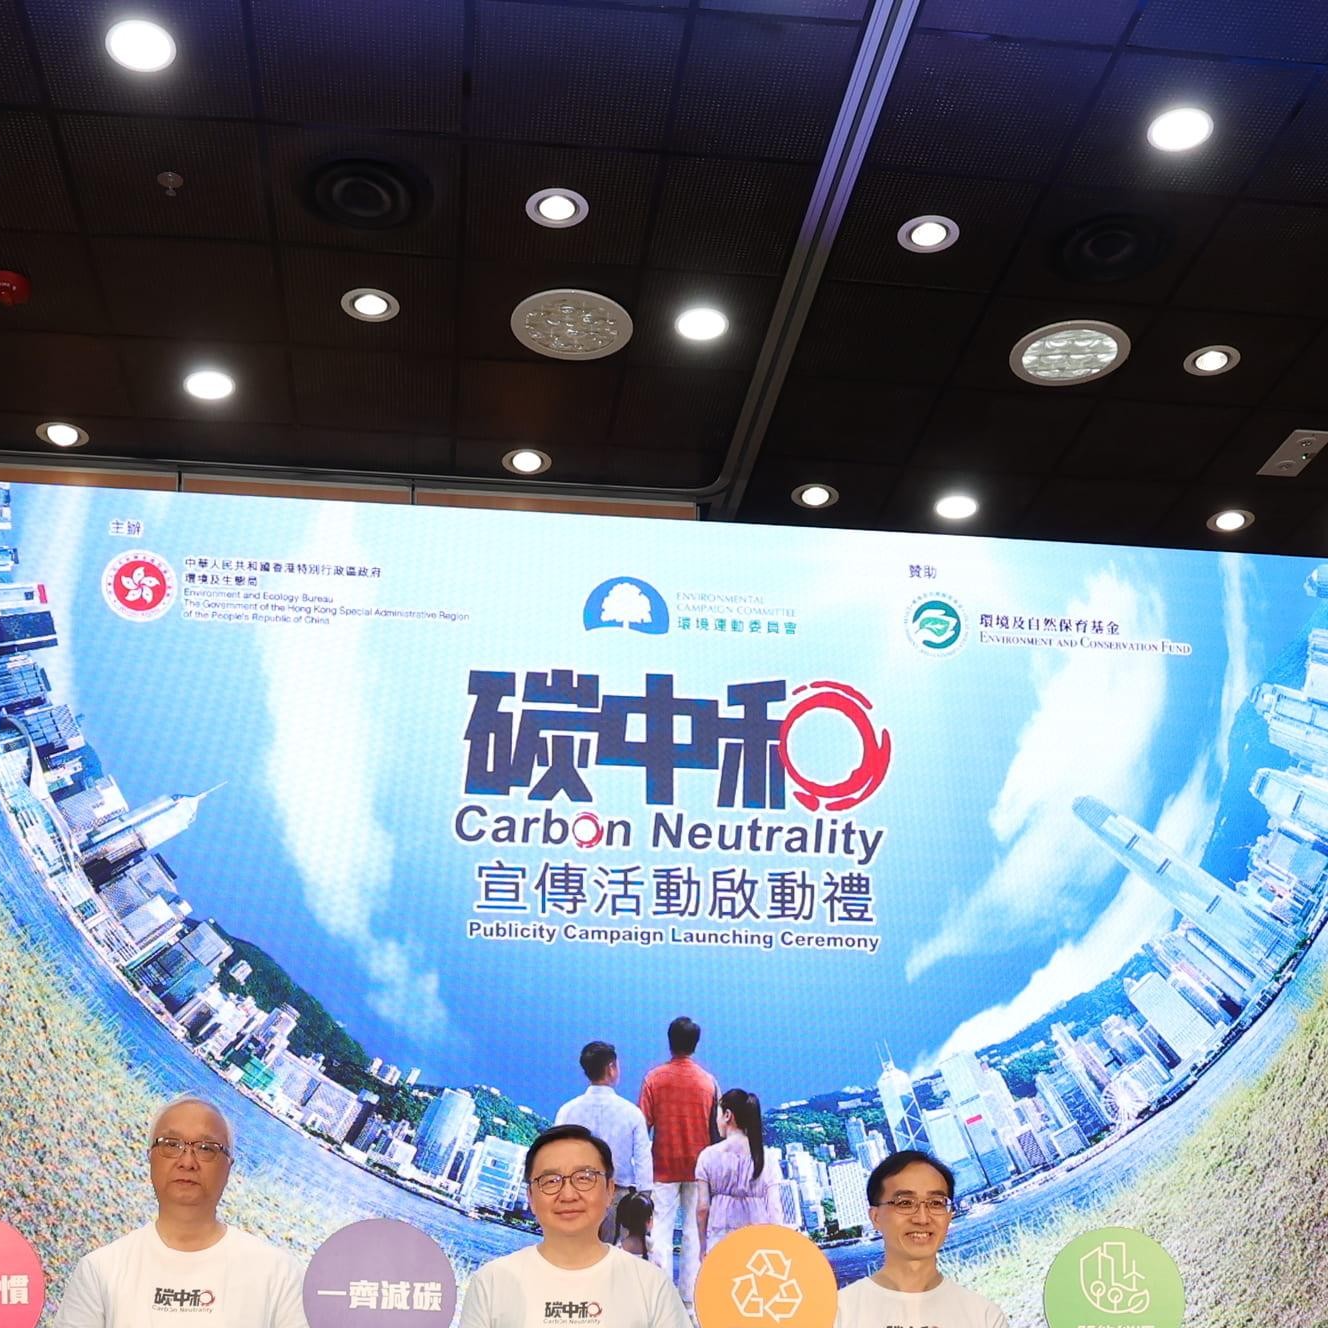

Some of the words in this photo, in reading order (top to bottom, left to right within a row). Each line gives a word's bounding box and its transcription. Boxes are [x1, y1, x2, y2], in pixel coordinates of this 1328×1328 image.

[185, 557, 381, 578] 中華人民共和國香港特別行政區政府
[909, 564, 937, 579] 贊助
[185, 573, 258, 586] 環境及生態局
[184, 587, 241, 599] Environment
[243, 591, 260, 599] and
[263, 592, 299, 604] Ecology
[302, 593, 333, 603] Bureau
[676, 592, 764, 604] ENVIRONMENTAL
[183, 610, 192, 618] of
[211, 612, 249, 621] People's
[252, 613, 291, 623] Republic
[293, 615, 302, 623] of
[304, 615, 329, 624] China
[184, 598, 200, 607] The
[202, 600, 257, 610] Government
[259, 603, 269, 611] of
[271, 603, 285, 611] the
[288, 604, 312, 614] Hong
[313, 605, 337, 616] Kong
[339, 606, 372, 616] Special
[374, 608, 437, 619] Administrative
[439, 611, 469, 621] Region
[677, 616, 797, 635] 環境運動委員會
[979, 614, 1120, 635] 環境及自然保育基金
[464, 669, 891, 811] 碳中和
[454, 804, 632, 848] Carbon
[652, 812, 884, 865] Neutrality
[476, 860, 874, 923] 宣傳活動啟動禮
[468, 921, 557, 942] Publicity
[563, 924, 664, 945] Campaign
[672, 926, 773, 949] Launching
[780, 931, 879, 952] Ceremony
[317, 1280, 442, 1311] 一齊減碳
